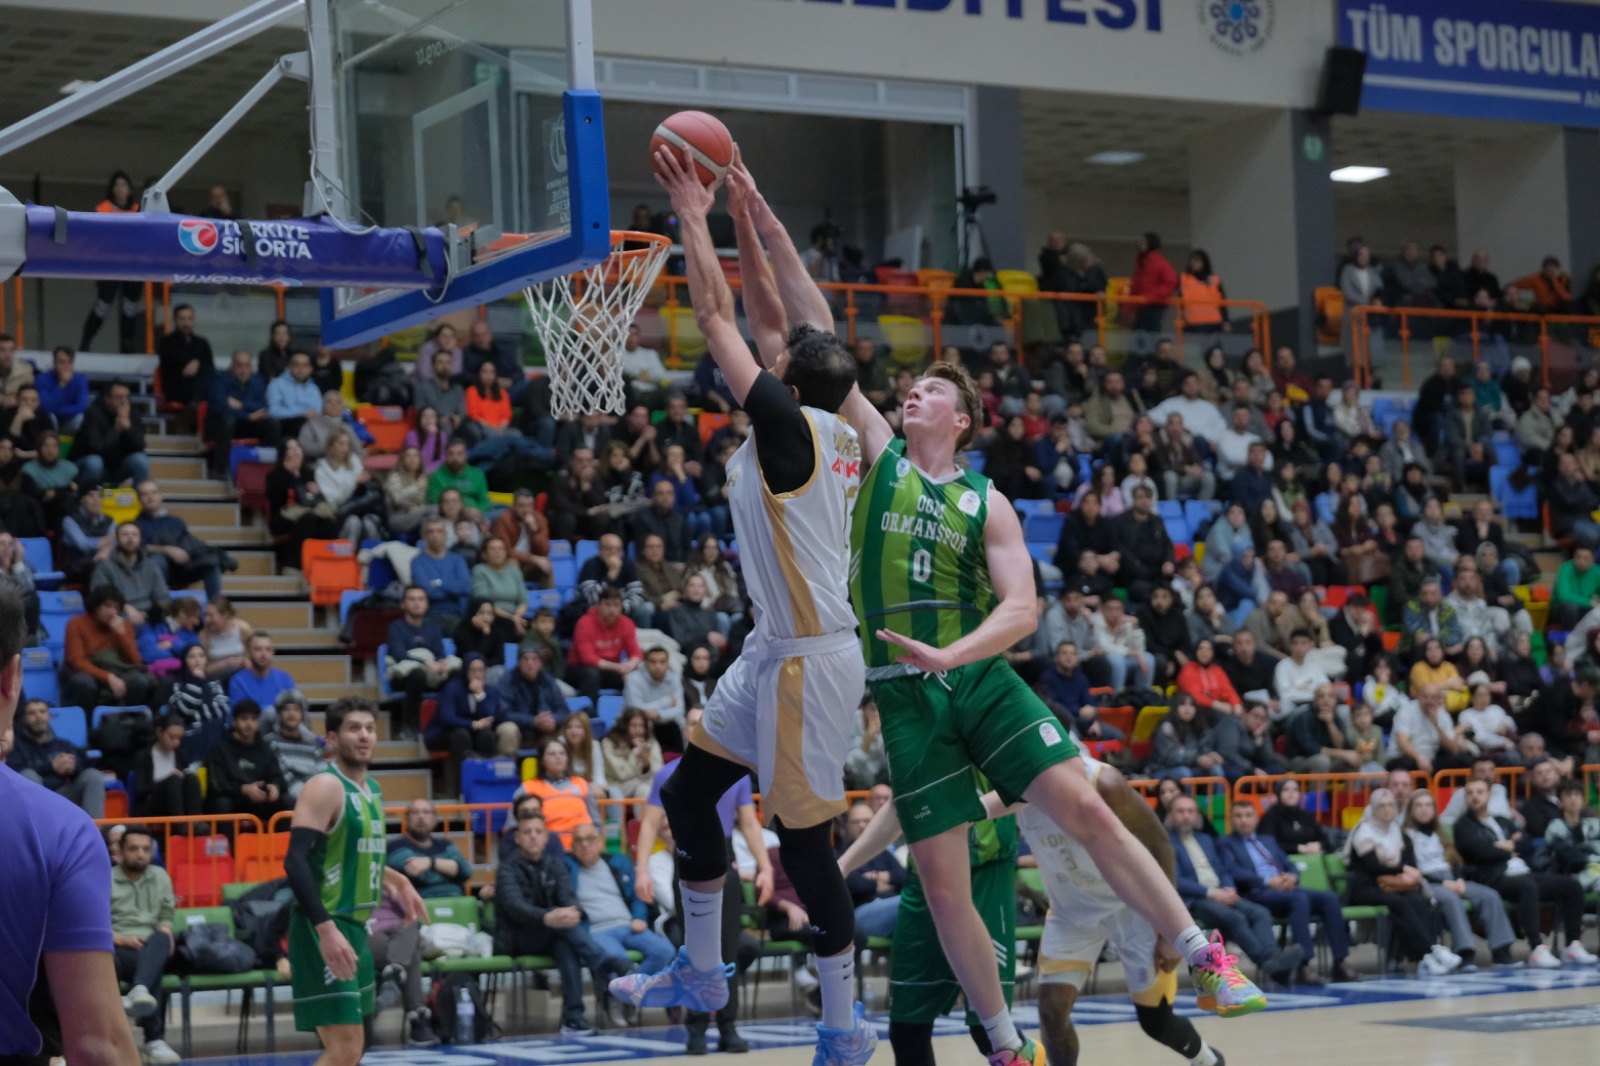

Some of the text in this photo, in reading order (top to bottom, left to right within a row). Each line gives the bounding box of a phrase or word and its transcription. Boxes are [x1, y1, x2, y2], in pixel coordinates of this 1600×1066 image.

[1347, 3, 1423, 63] TÜM
[1433, 17, 1600, 80] SPORCULA
[880, 511, 968, 554] ORMANSPOR
[913, 548, 931, 583] 0
